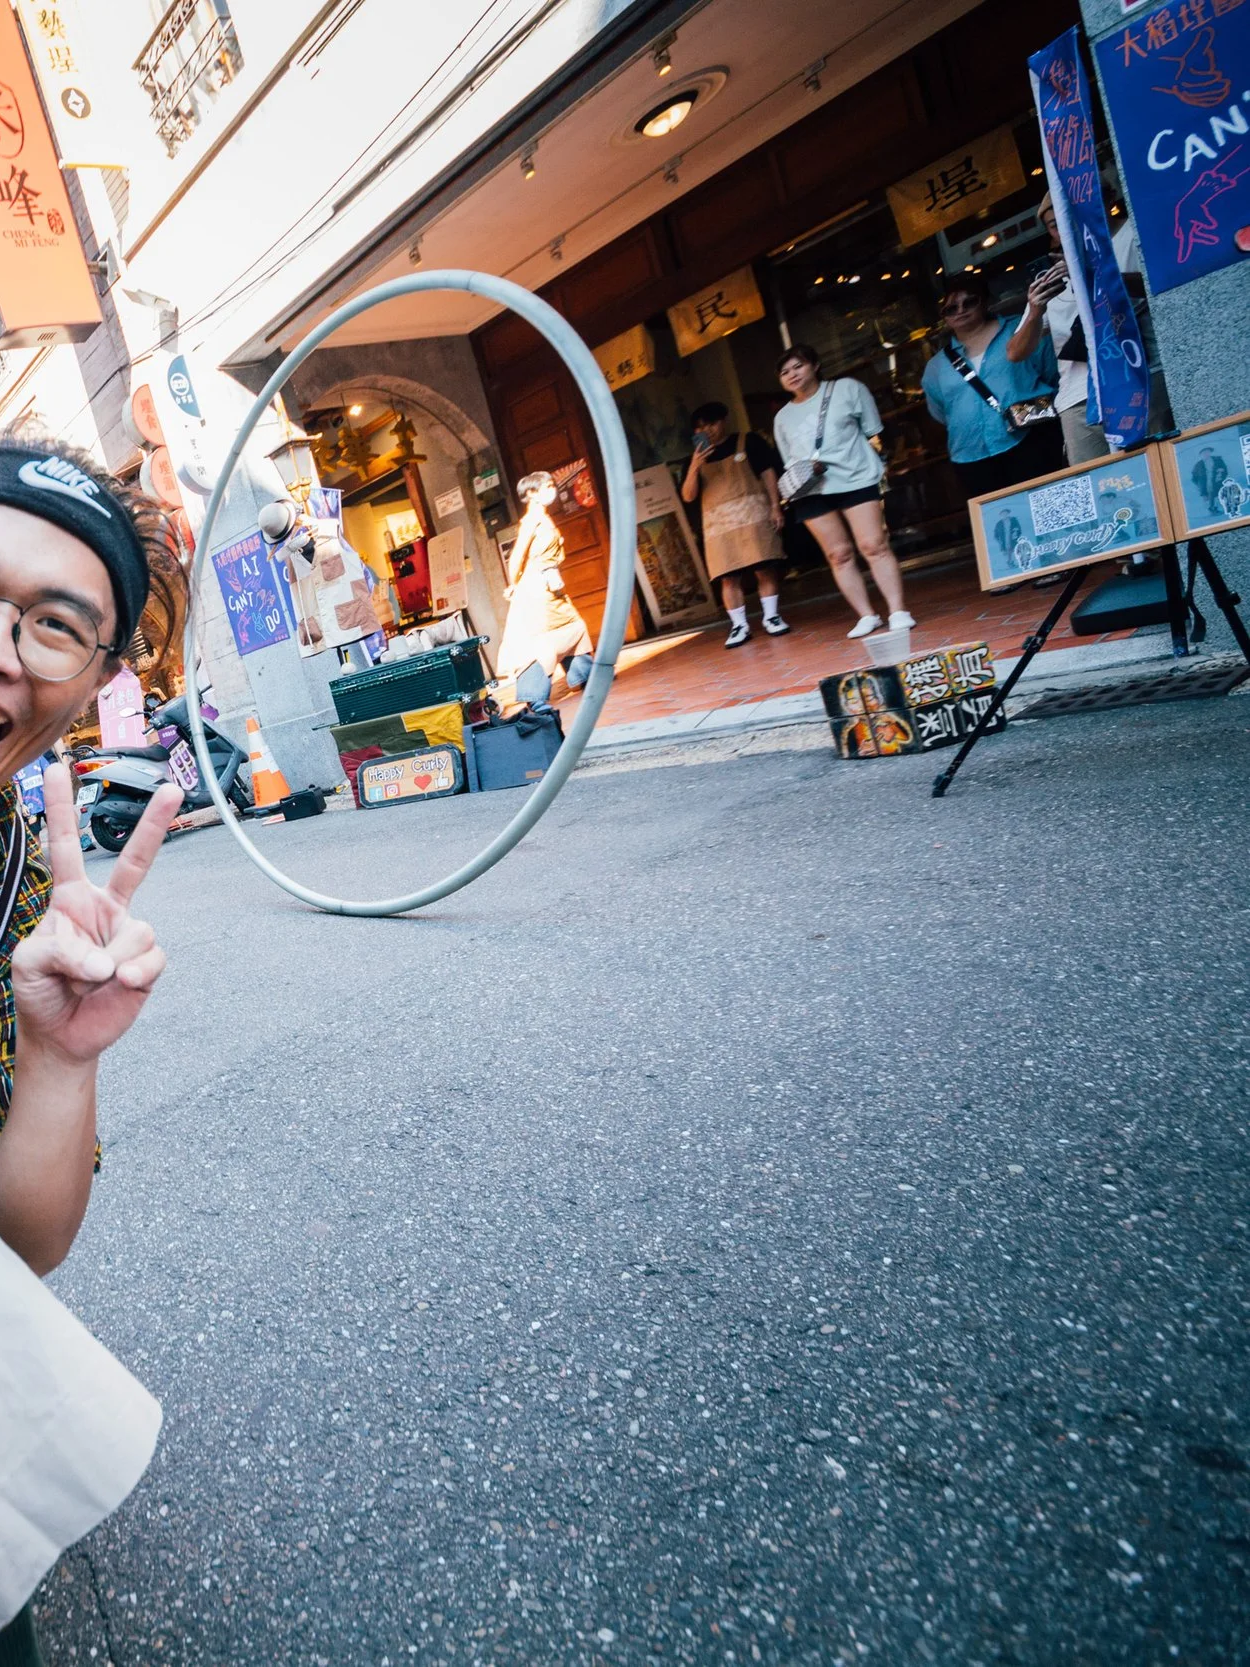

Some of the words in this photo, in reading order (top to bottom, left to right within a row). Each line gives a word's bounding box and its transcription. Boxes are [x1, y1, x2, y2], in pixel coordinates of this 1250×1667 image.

[924, 156, 988, 212] 埕
[1067, 171, 1096, 204] 2024
[695, 291, 739, 334] 民
[37, 455, 100, 496] NIKE
[241, 555, 261, 577] AI
[228, 590, 254, 614] CAN'T
[265, 608, 280, 633] DO
[368, 765, 405, 783] Happy
[411, 755, 450, 773] Curly
